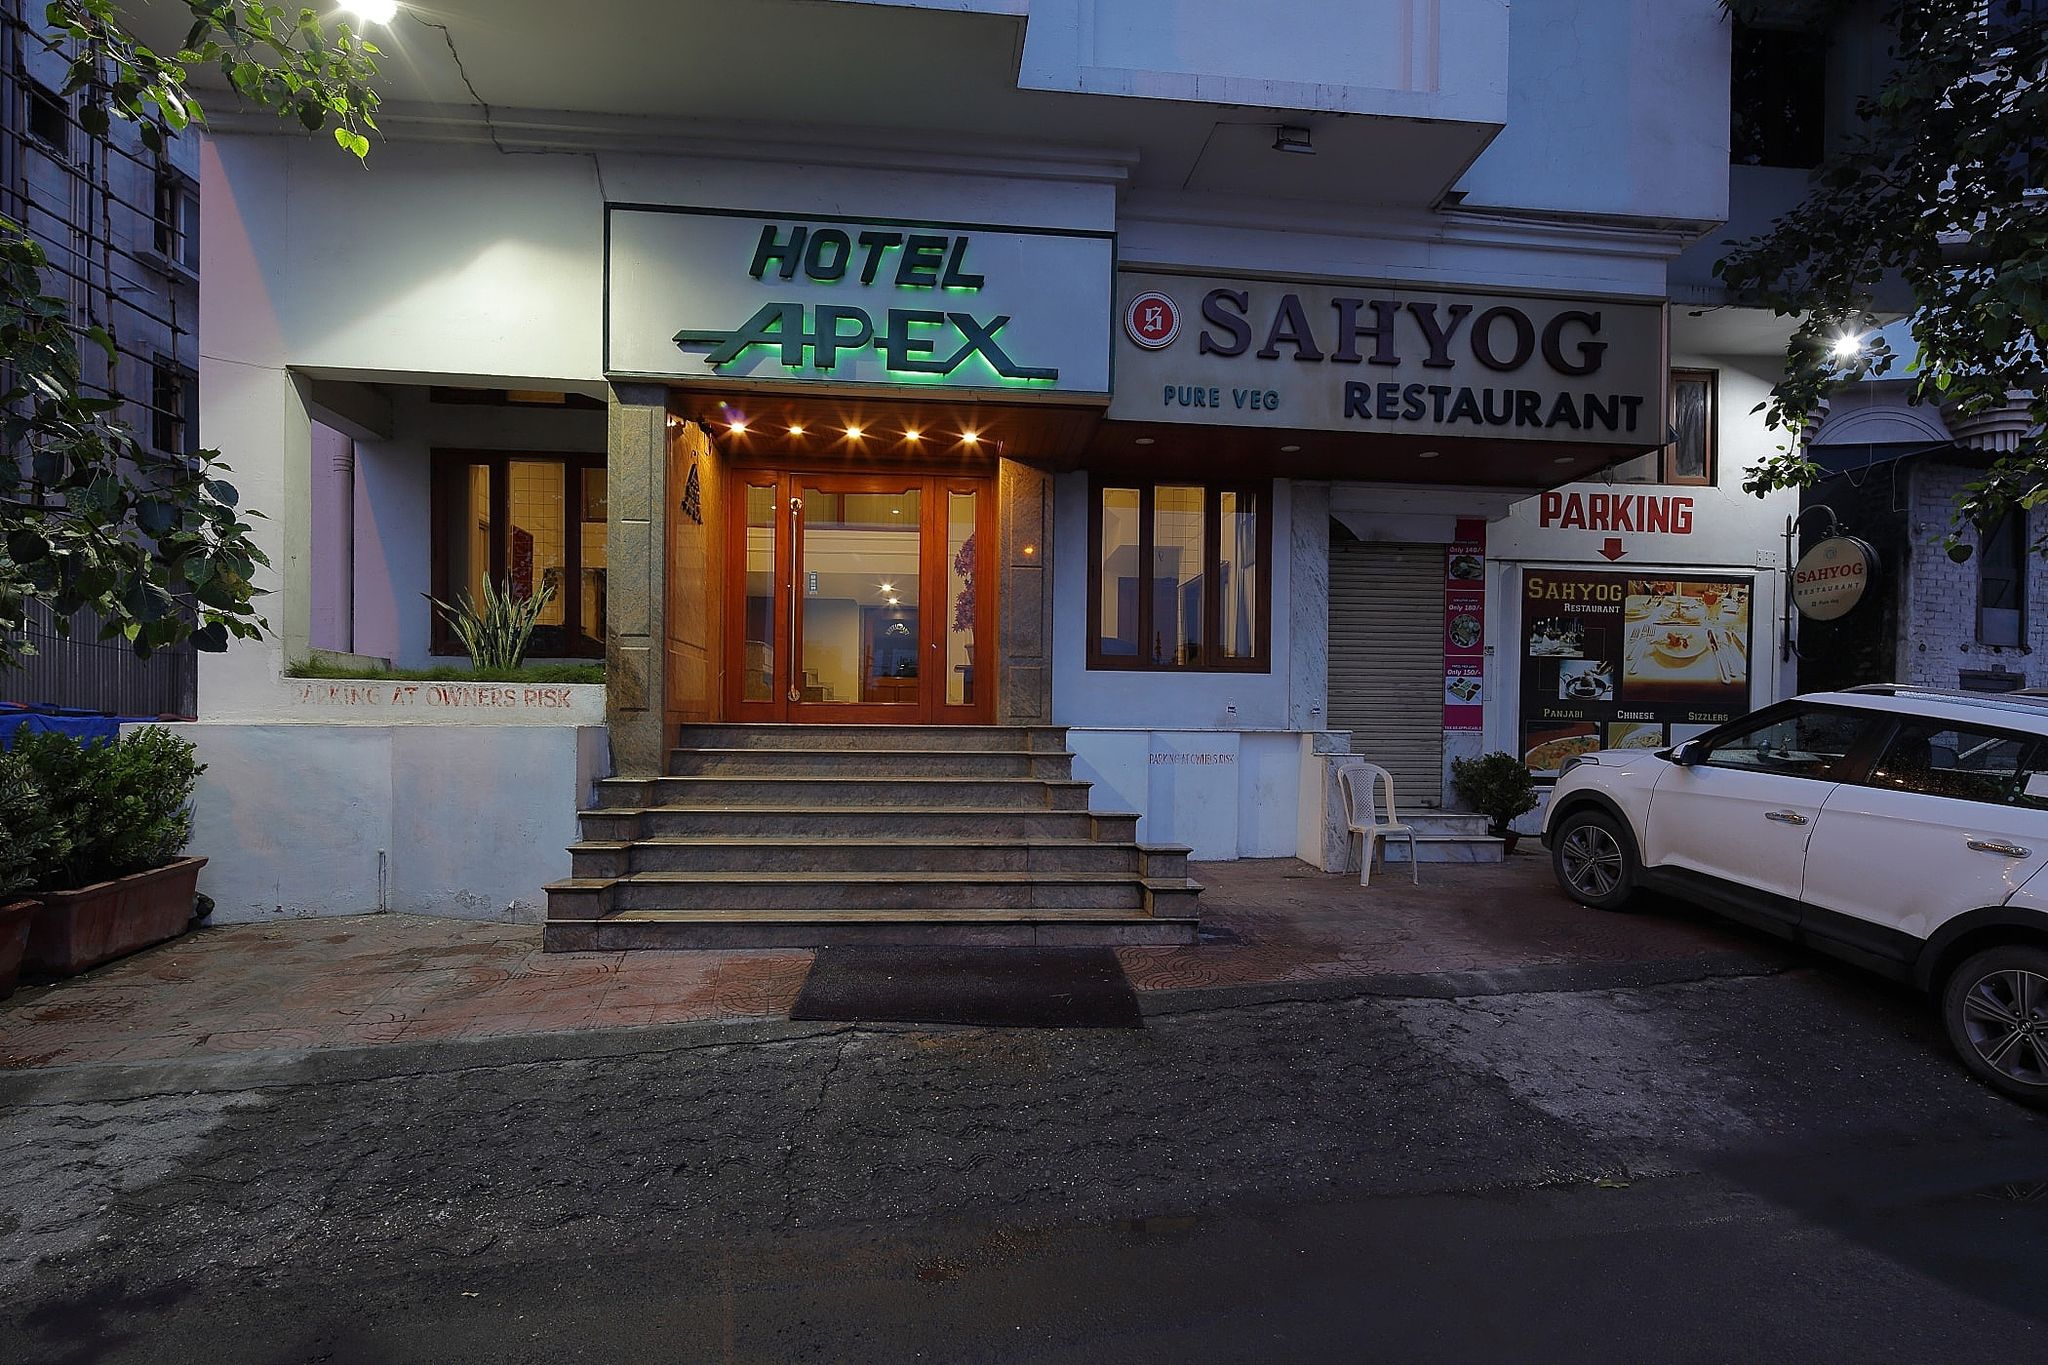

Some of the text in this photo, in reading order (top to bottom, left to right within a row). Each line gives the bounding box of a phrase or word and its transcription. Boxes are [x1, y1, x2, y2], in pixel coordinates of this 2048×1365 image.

[748, 225, 985, 289] HOTEL
[672, 302, 1059, 381] APEX
[1199, 288, 1608, 376] SAHYOG
[1164, 385, 1280, 410] PURE VEG
[1344, 381, 1644, 432] RESTAURANT
[1539, 491, 1694, 534] PARKING
[1796, 562, 1864, 584] SAHYOG
[1528, 577, 1622, 601] SAHYOG
[1798, 582, 1860, 596] RESTAURANT
[1564, 602, 1621, 613] RESTAURANT
[391, 685, 419, 706] AT
[425, 686, 516, 708] OWNERS
[523, 687, 572, 708] RISK
[1544, 708, 1583, 719] PANJABI
[1617, 710, 1655, 720] CHINESE
[1688, 711, 1729, 722] SIZZLERS
